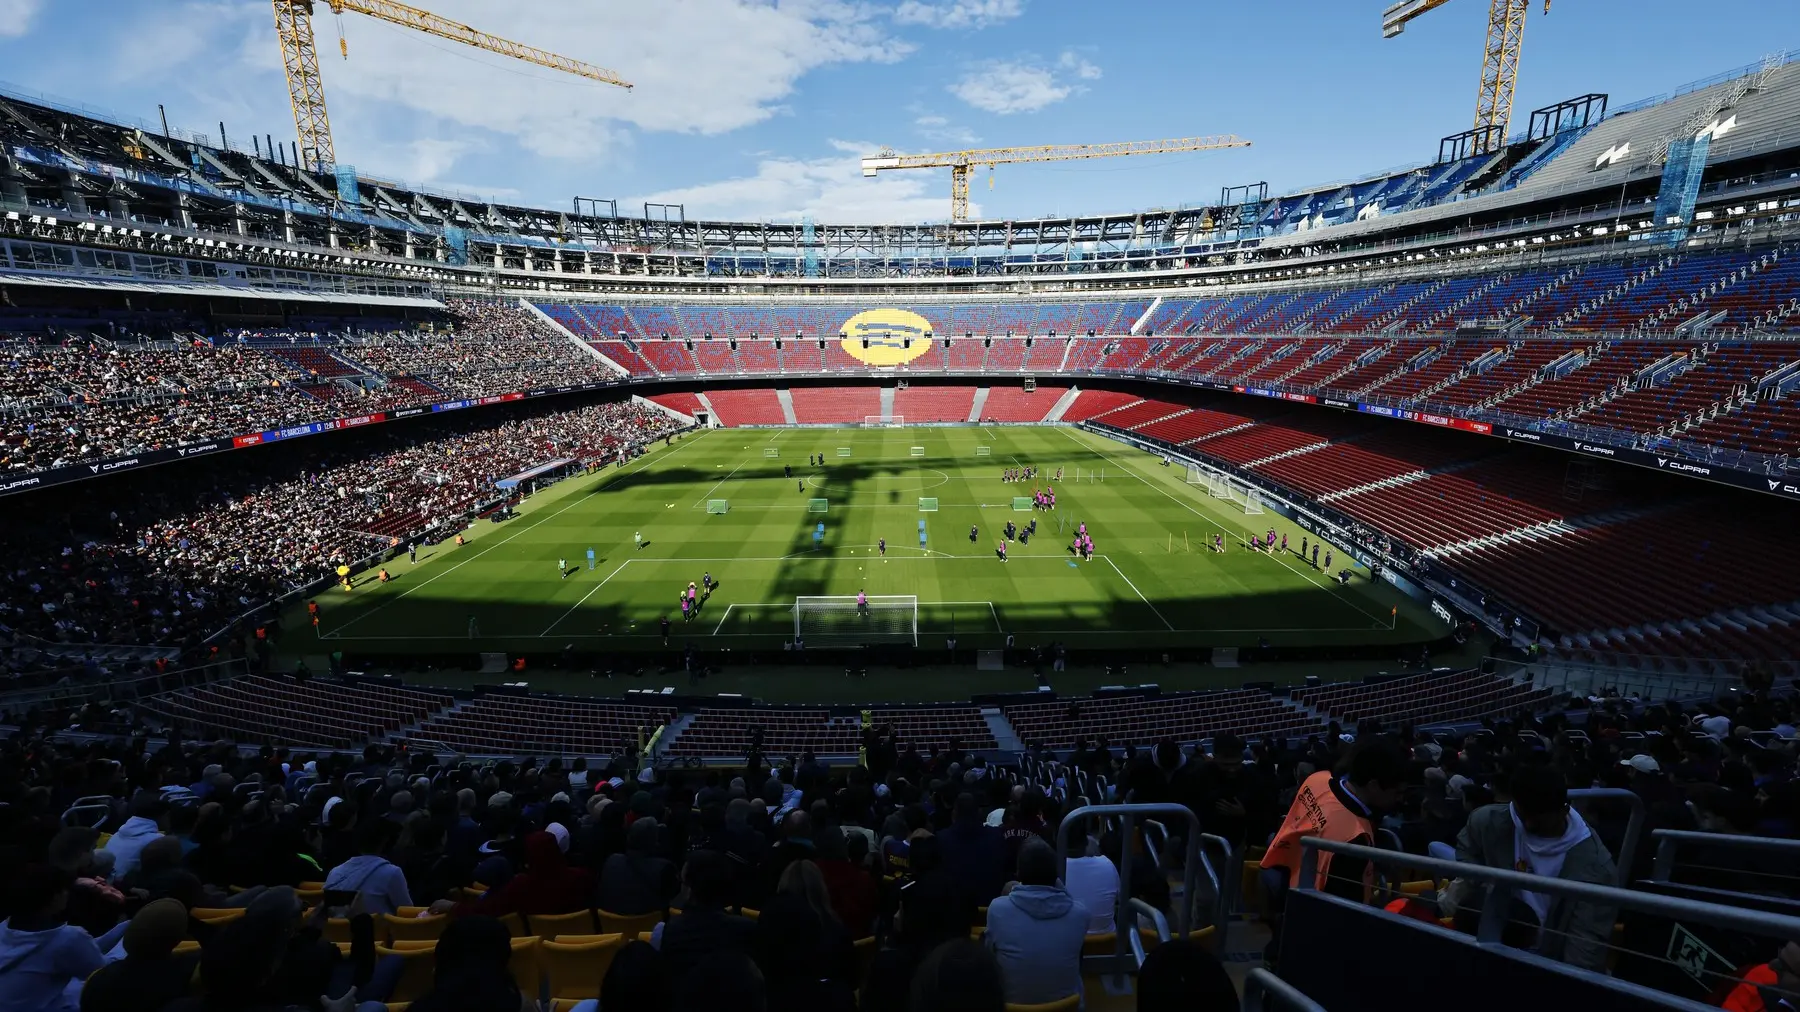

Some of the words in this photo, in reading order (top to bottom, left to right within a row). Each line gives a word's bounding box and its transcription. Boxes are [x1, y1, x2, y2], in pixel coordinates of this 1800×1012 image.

[1428, 415, 1448, 425] BARCELONA
[281, 430, 287, 438] FC
[288, 426, 310, 436] BARCELONA
[1514, 432, 1540, 440] CUPRA
[188, 444, 217, 454] CUPRA
[1583, 445, 1614, 455] CUPRA
[103, 458, 138, 470] CUPRA
[1670, 462, 1710, 475] CUPRA
[1321, 530, 1351, 554] CUPRA
